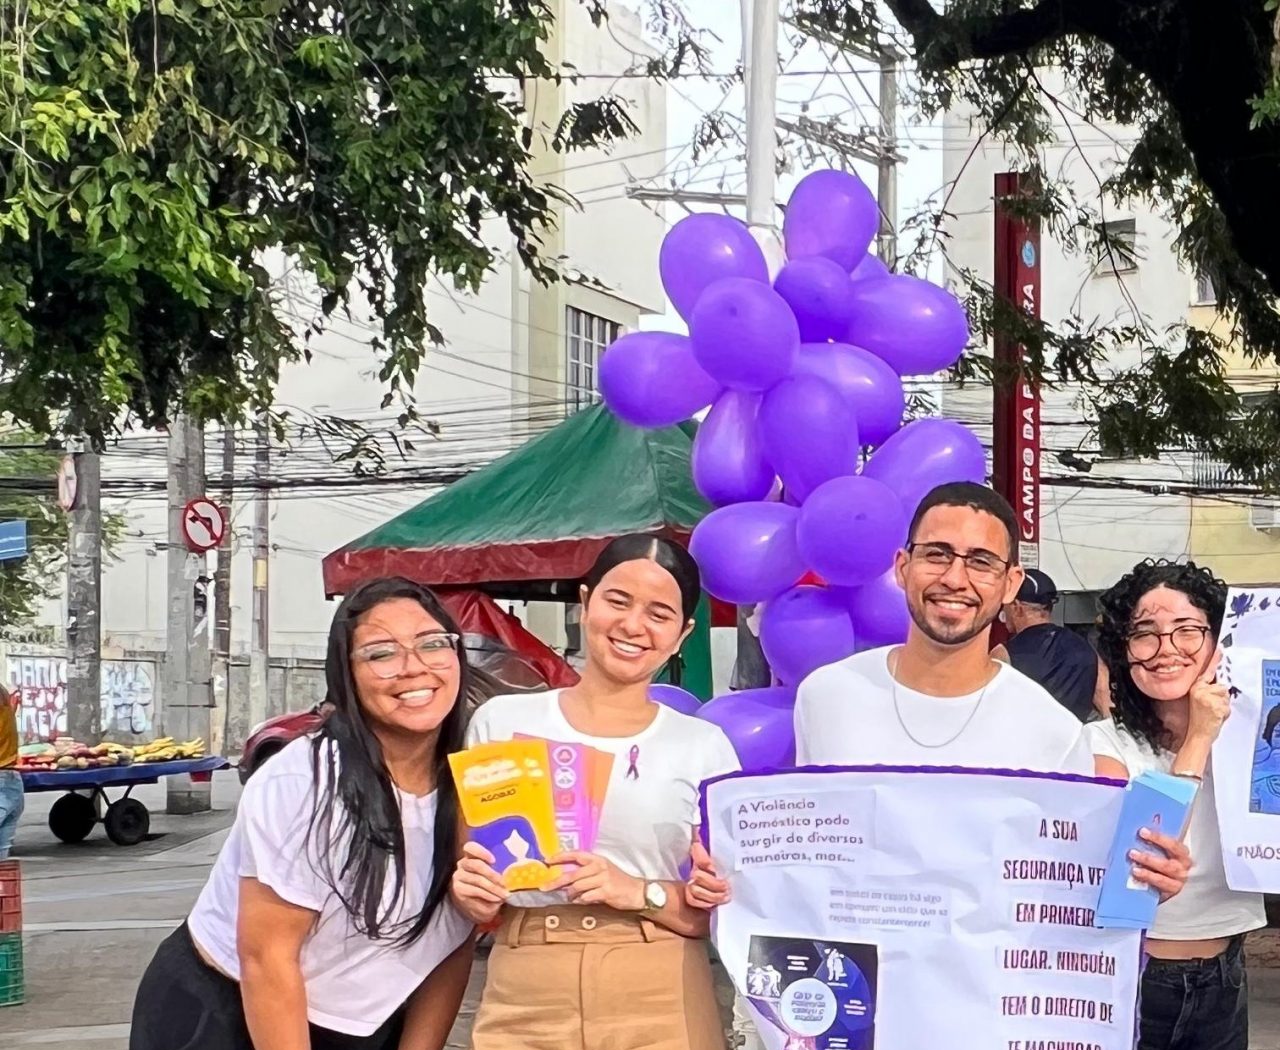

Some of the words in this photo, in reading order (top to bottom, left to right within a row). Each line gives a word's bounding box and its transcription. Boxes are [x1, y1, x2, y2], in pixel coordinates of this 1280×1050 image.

[1022, 406, 1034, 441] DA
[1022, 447, 1034, 540] CAMPO
[738, 804, 748, 815] A
[741, 834, 782, 848] surgir
[786, 832, 803, 844] de
[1039, 818, 1048, 838] A
[1052, 820, 1078, 841] SUA
[1003, 859, 1084, 890] SEGURANÇA
[1088, 866, 1106, 886] VE
[1016, 903, 1036, 923] EM
[1039, 904, 1104, 929] PRIMEIR
[1003, 949, 1052, 970] LUGAR.
[1057, 950, 1115, 976] NINGUÉM
[1001, 996, 1027, 1016] TEM
[1031, 996, 1040, 1015] O
[1044, 997, 1095, 1019] DIREITO
[1100, 1002, 1113, 1024] DE
